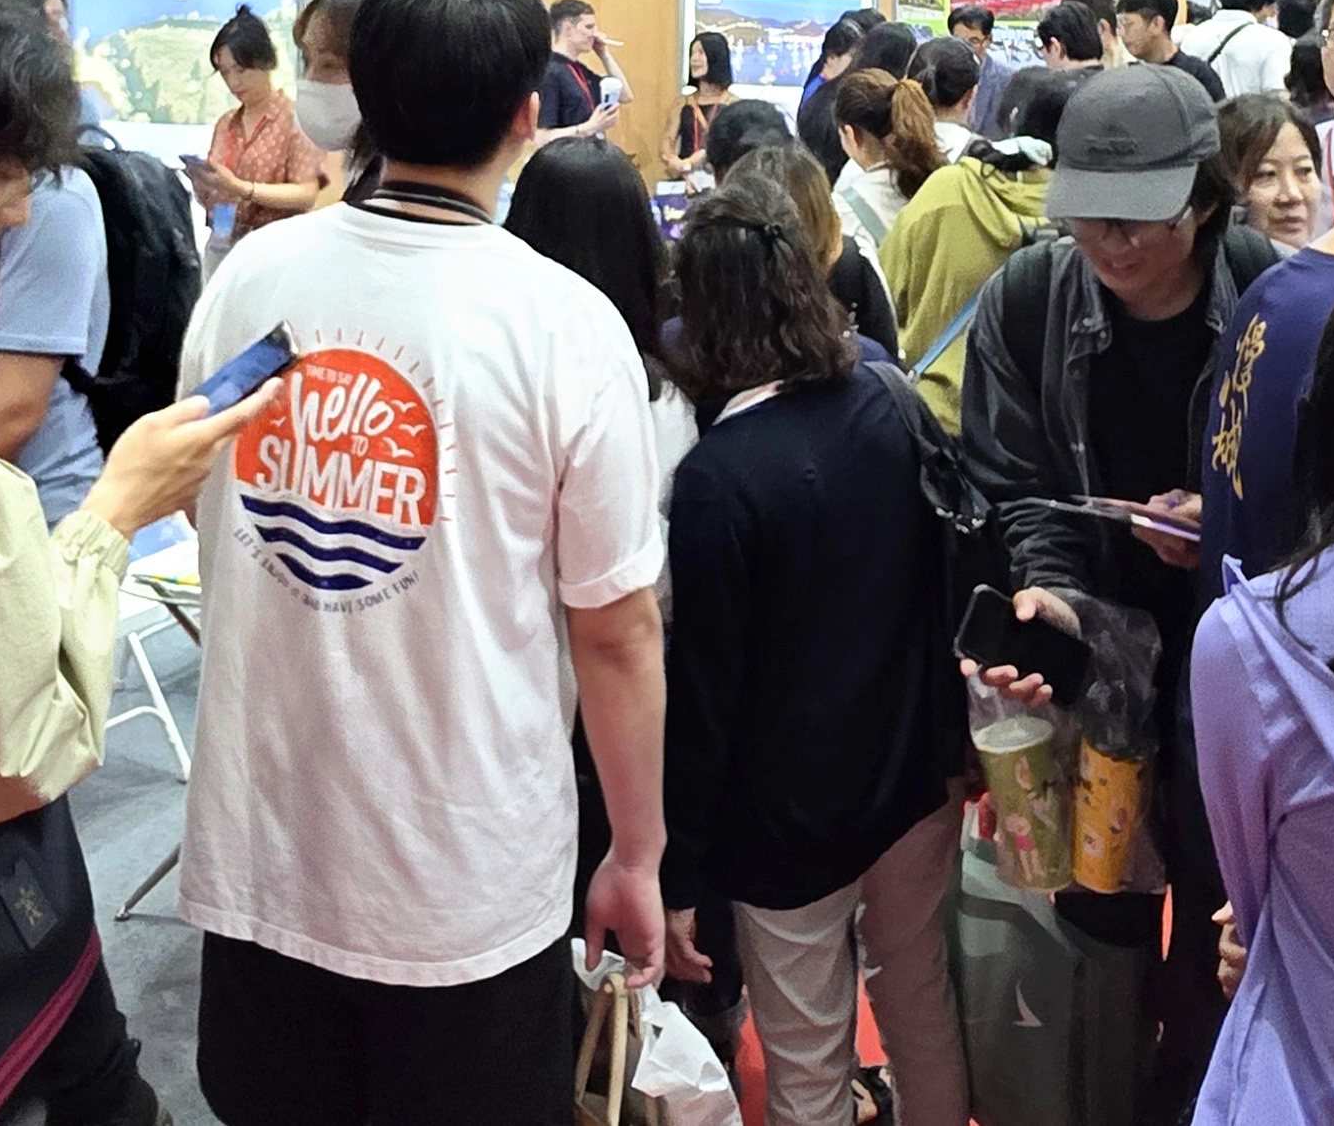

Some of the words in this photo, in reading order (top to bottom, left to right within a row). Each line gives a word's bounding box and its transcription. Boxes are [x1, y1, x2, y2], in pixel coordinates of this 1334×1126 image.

[290, 371, 395, 444] hello
[351, 434, 369, 458] TO
[255, 435, 427, 527] SUMMER
[357, 587, 394, 612] SOME
[391, 568, 421, 596] FUN!
